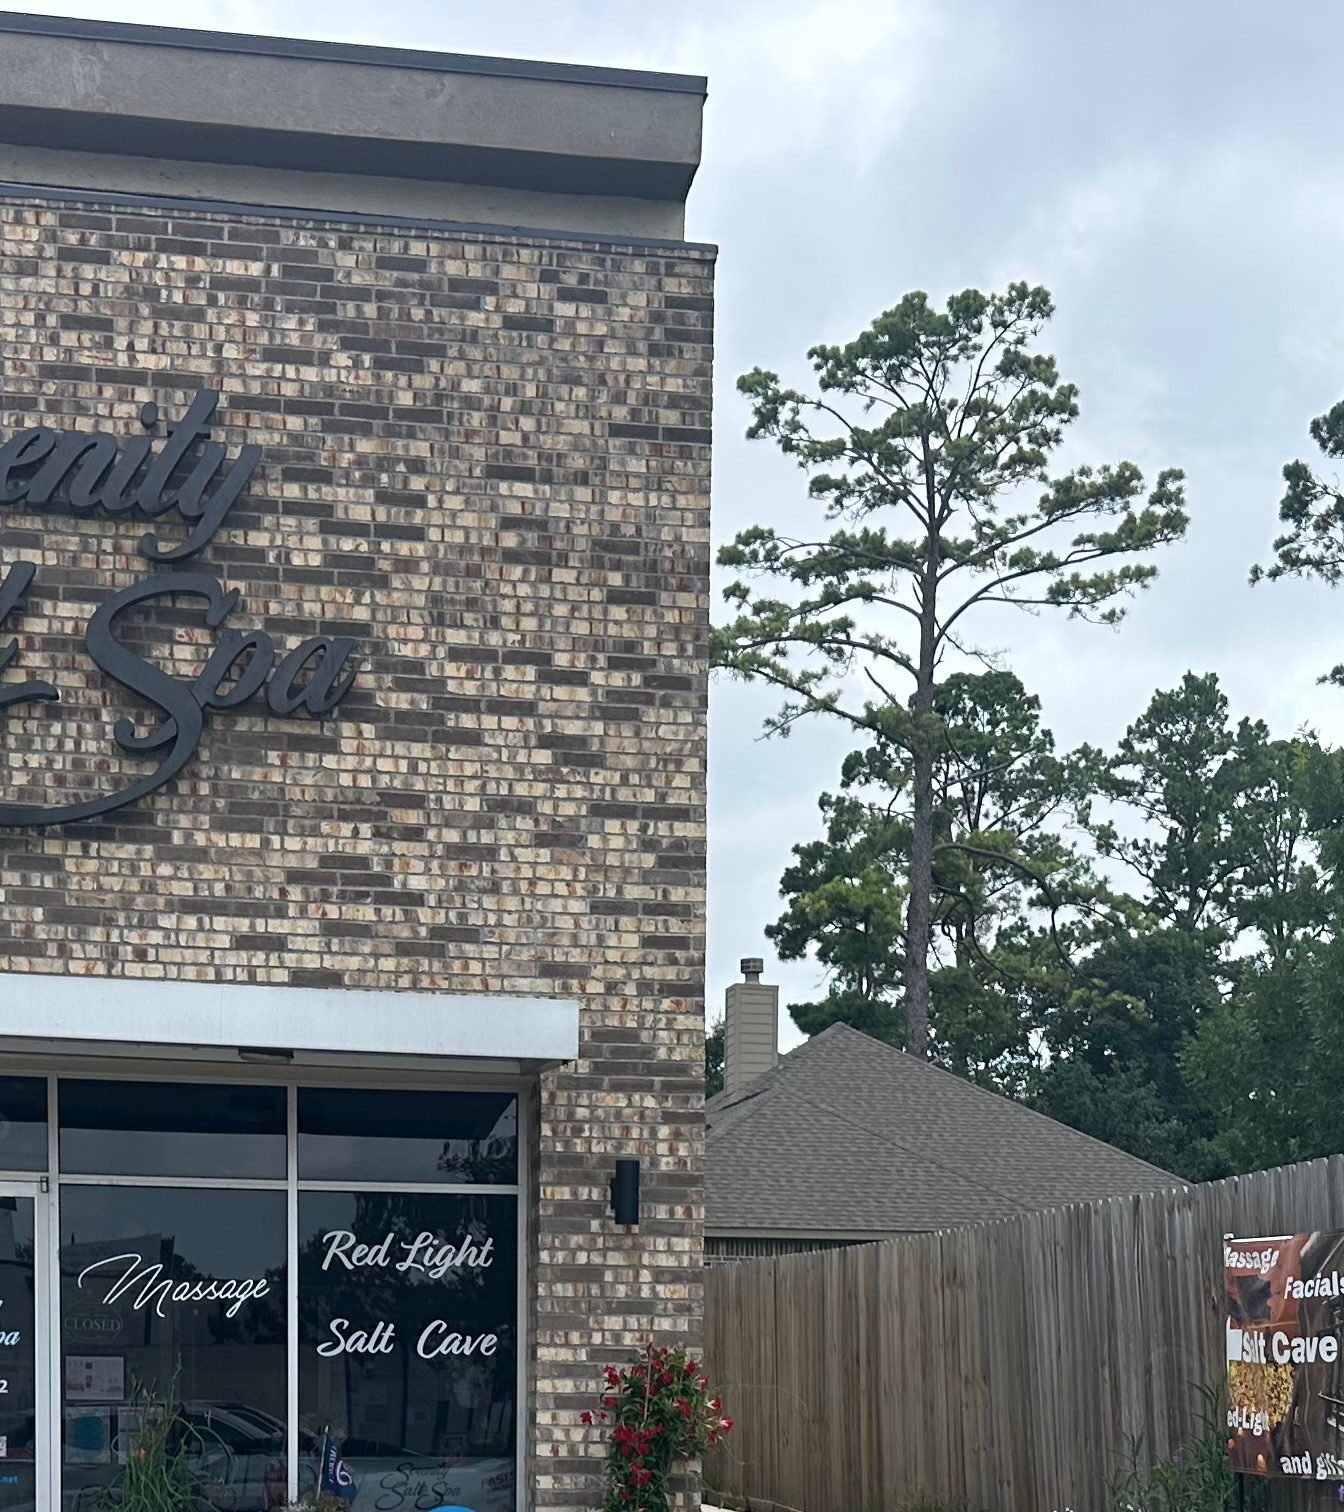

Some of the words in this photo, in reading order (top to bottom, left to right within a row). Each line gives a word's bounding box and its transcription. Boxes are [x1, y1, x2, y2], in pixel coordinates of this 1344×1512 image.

[321, 1230, 395, 1271] Red
[396, 1232, 494, 1279] Light
[78, 1254, 270, 1318] Massage
[65, 1316, 122, 1332] CLOSED
[317, 1318, 395, 1357] Salt
[417, 1320, 497, 1359] Cave
[1272, 1331, 1337, 1365] Cave
[1280, 1450, 1312, 1474] and
